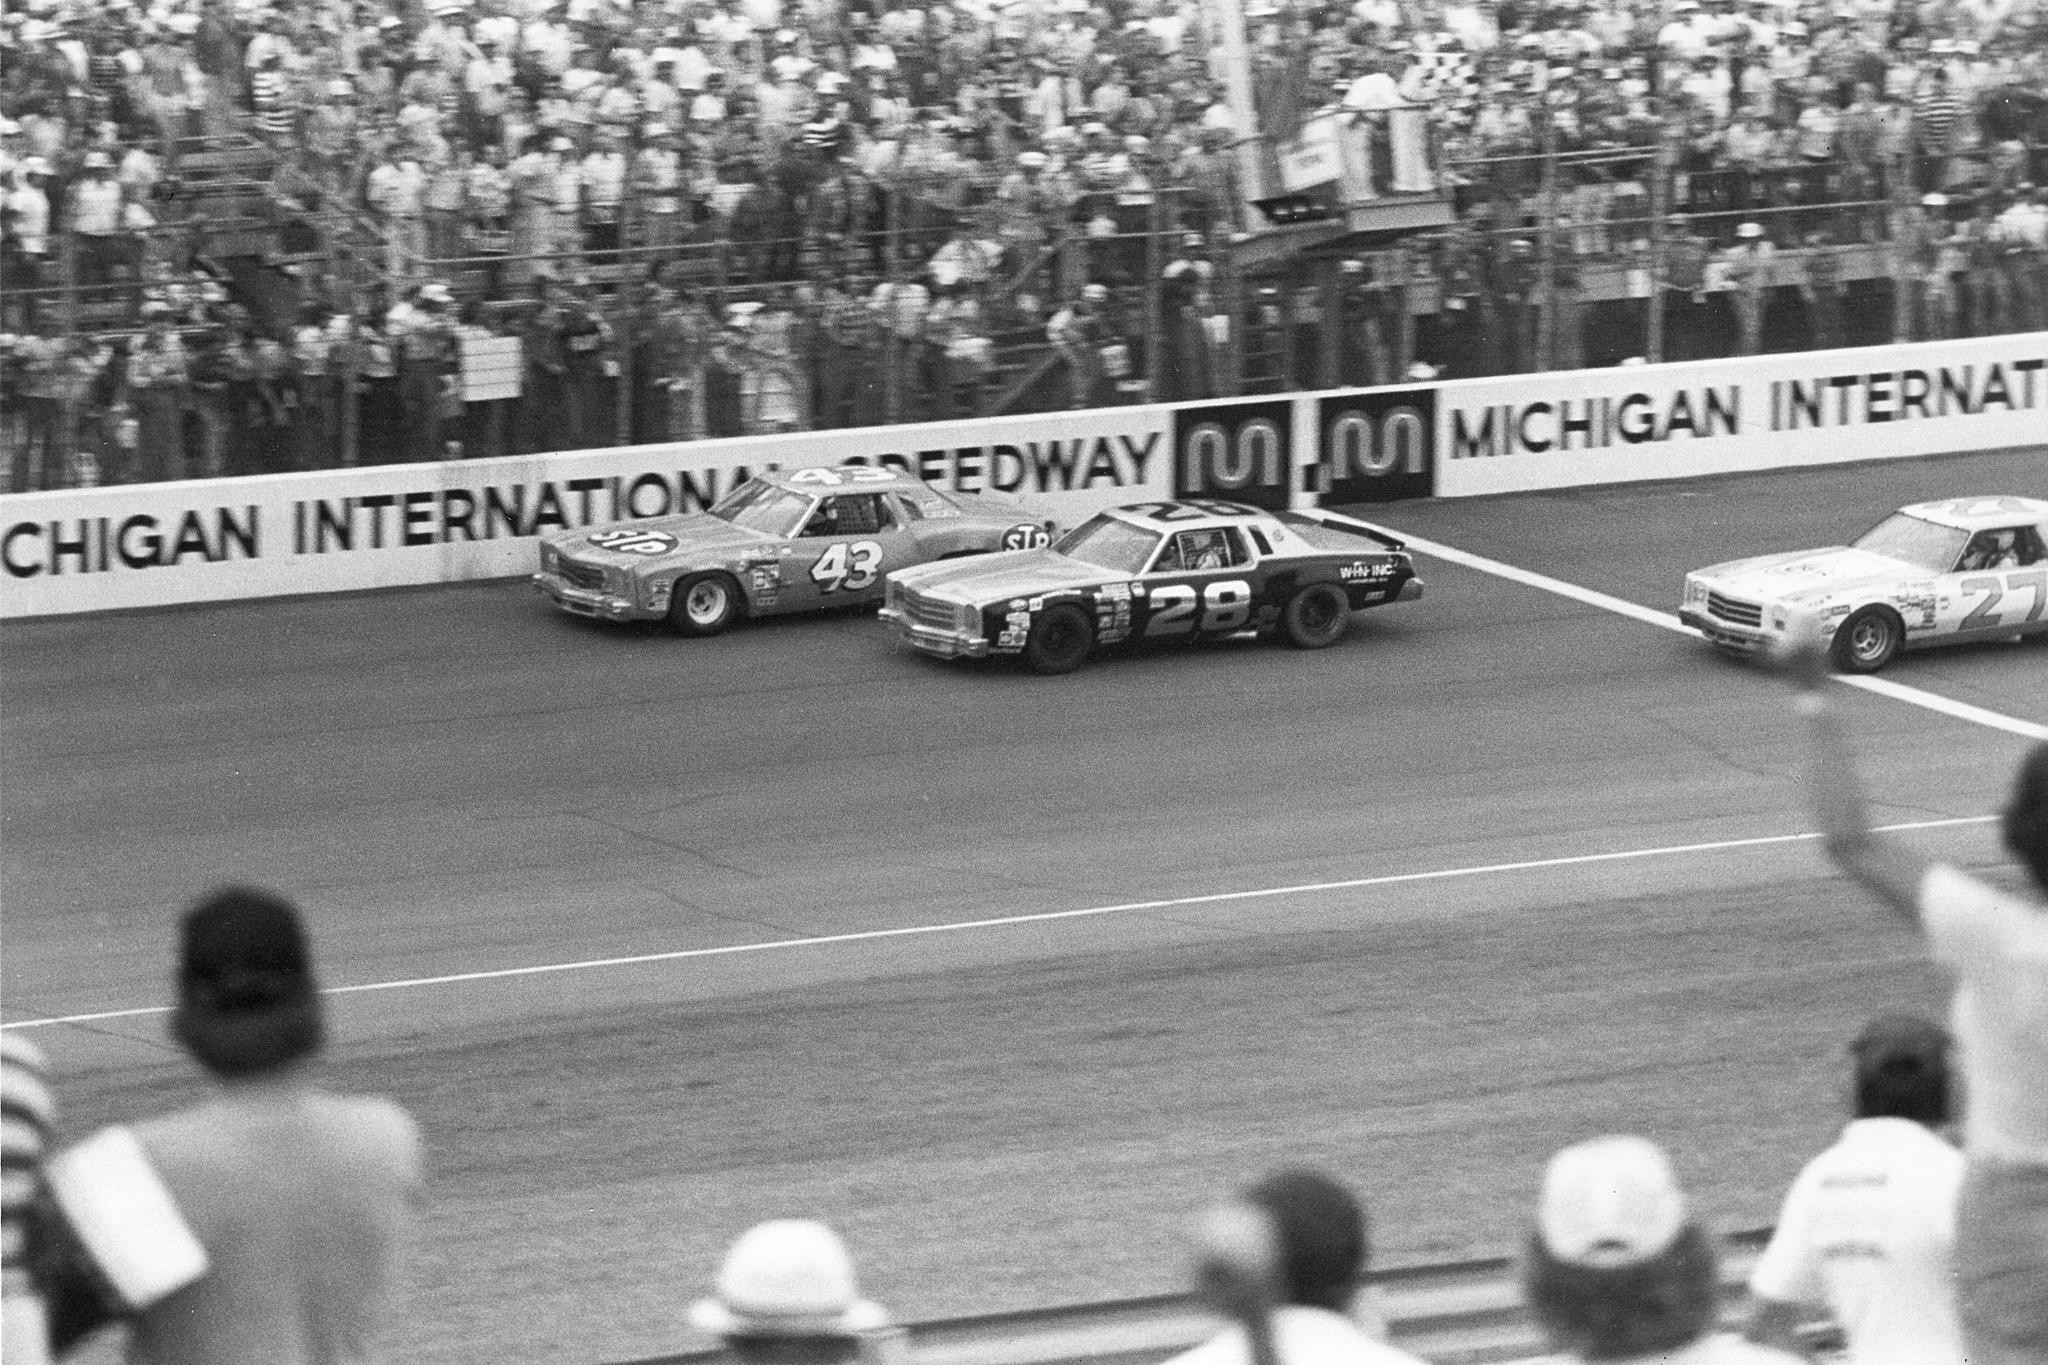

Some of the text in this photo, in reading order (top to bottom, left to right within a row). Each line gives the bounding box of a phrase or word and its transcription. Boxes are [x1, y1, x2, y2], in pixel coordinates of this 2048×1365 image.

[1450, 358, 2048, 459] MICHIGAN INTERNAT
[790, 467, 897, 485] 43
[1, 431, 1165, 579] CHIGAN INTERNATION EEDWAY
[589, 530, 673, 552] STP
[1006, 526, 1049, 550] STP
[809, 541, 883, 593] 43
[1145, 580, 1251, 636] 28
[1958, 571, 2048, 632] 27
